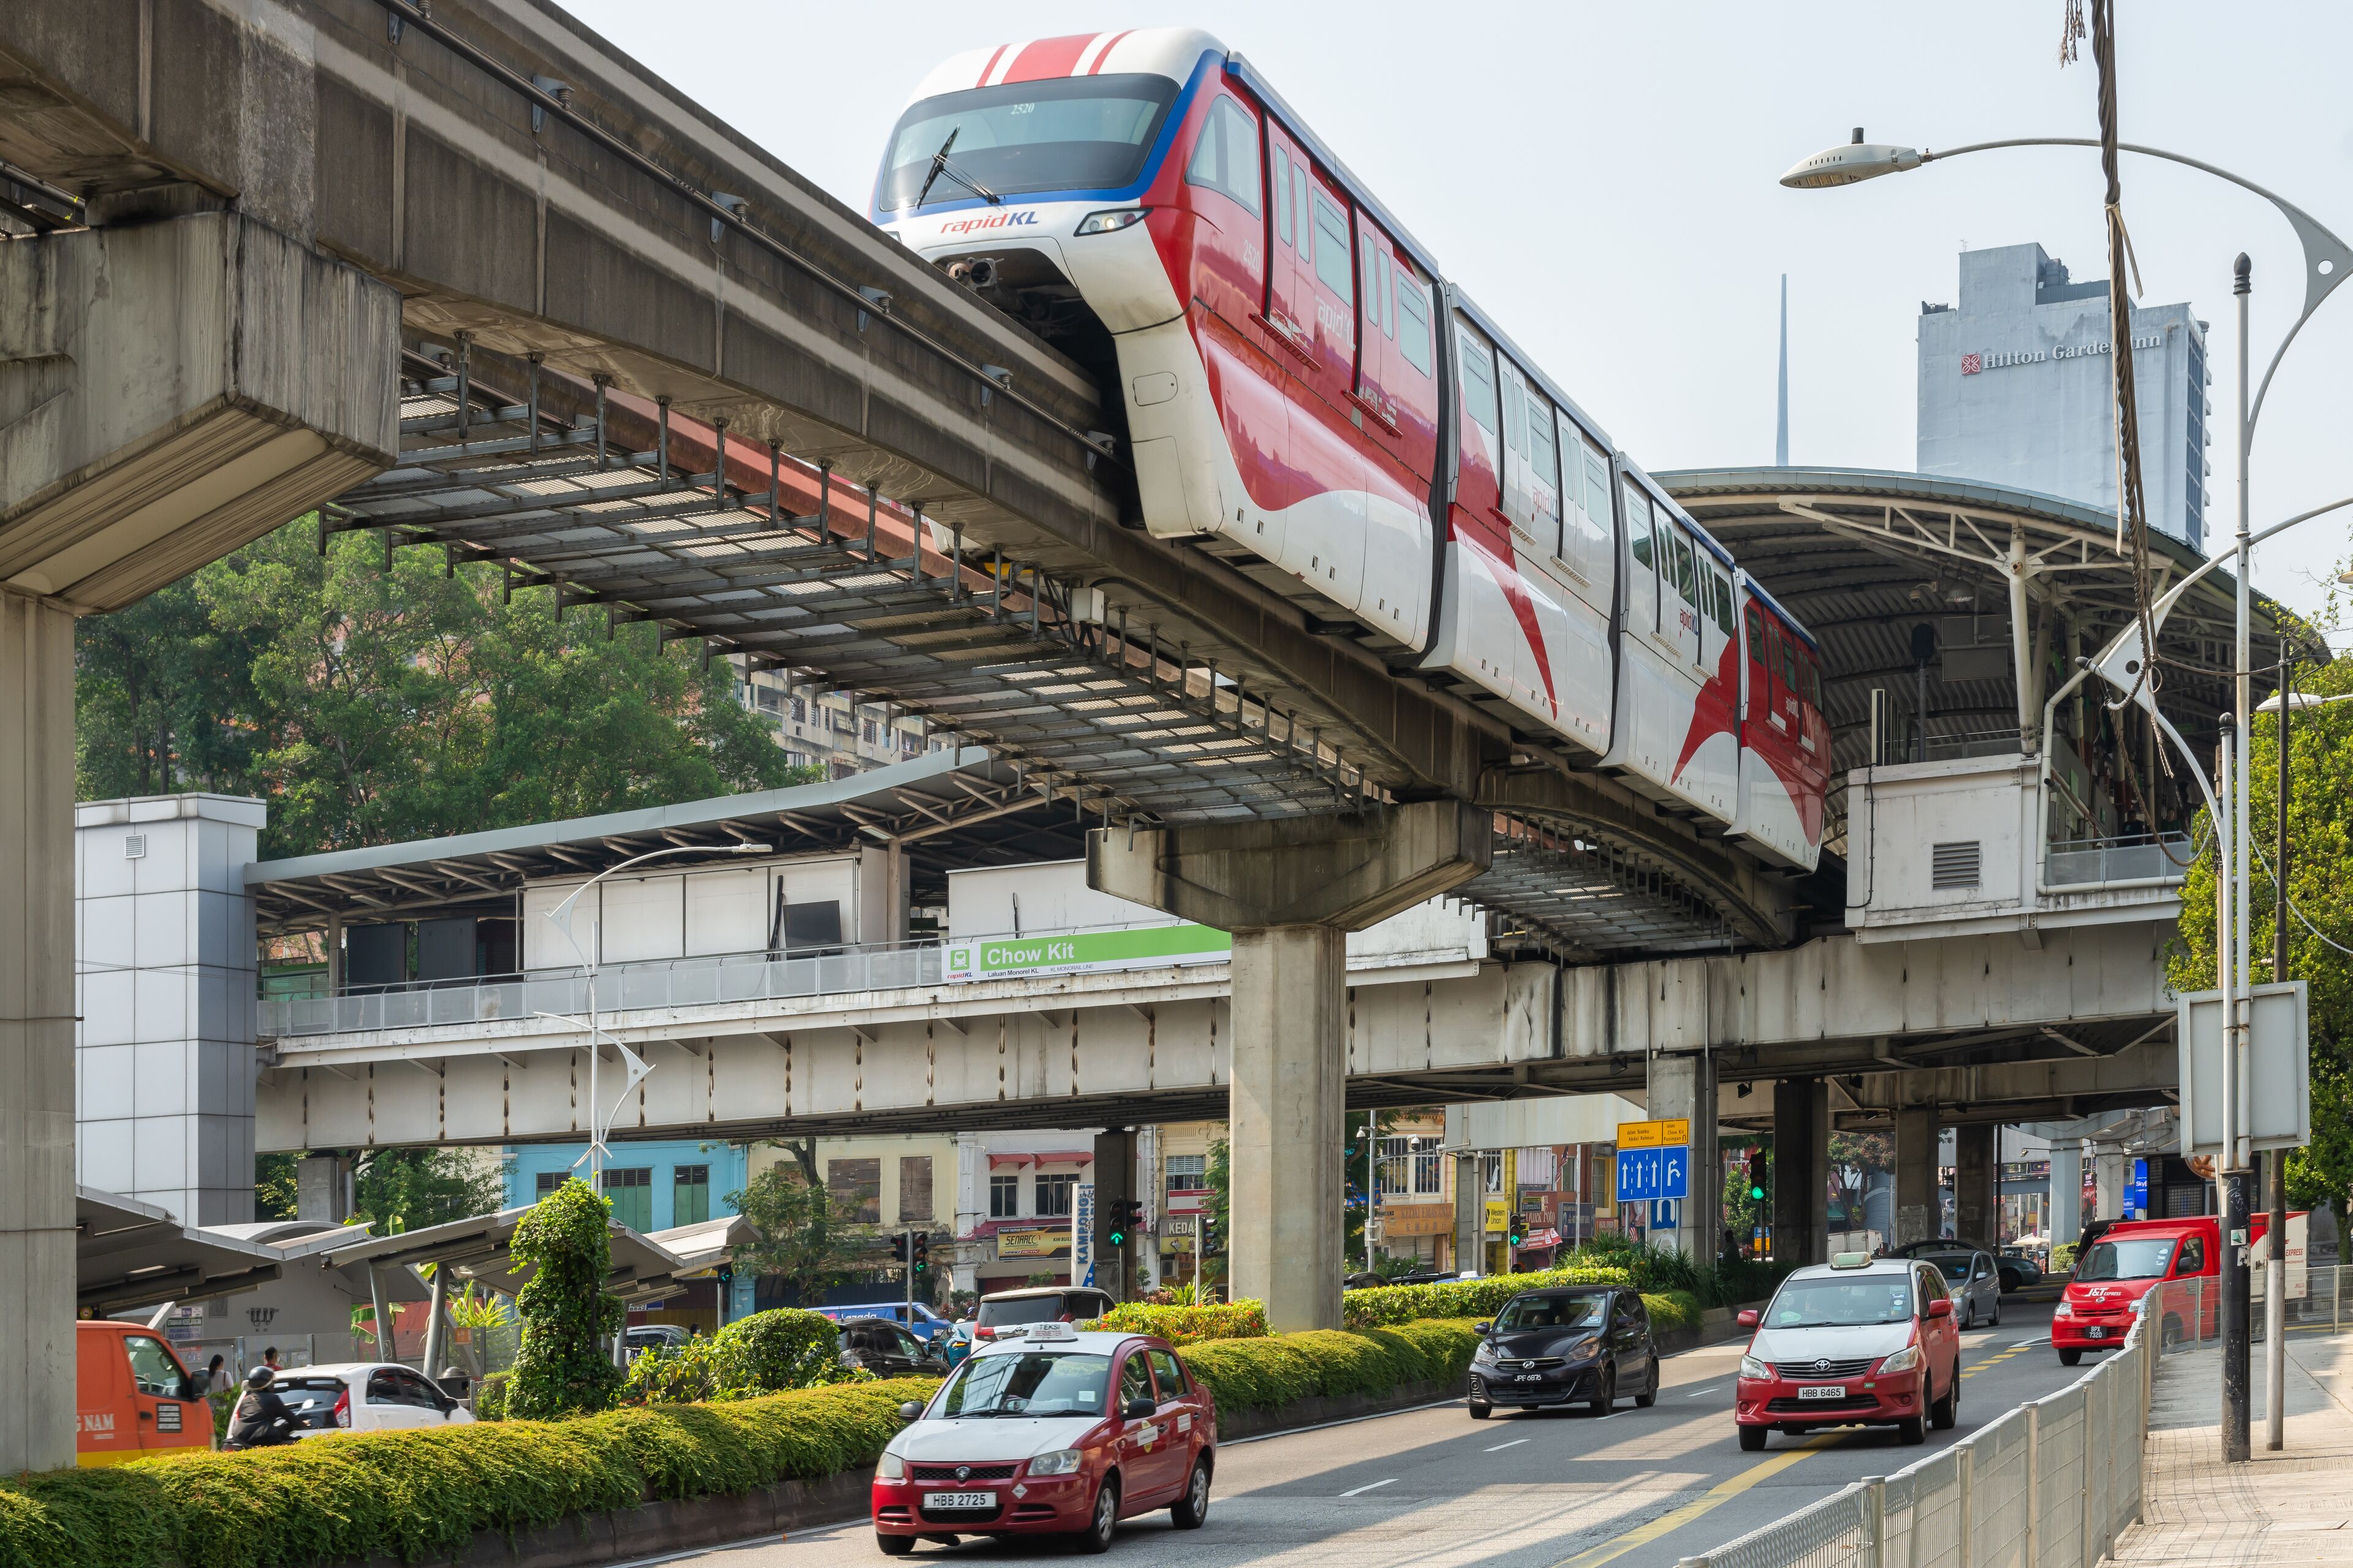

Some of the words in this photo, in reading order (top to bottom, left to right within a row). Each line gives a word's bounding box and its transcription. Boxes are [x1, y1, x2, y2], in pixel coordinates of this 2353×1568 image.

[1011, 102, 1034, 115] 2520
[941, 211, 1039, 234] rapidKL
[1243, 239, 1260, 273] 2520
[1983, 350, 2047, 369] Hilton
[1533, 485, 1559, 524] apidKL
[1680, 608, 1698, 636] apidKL
[987, 947, 1042, 965] Chow
[1048, 942, 1074, 960] Kit
[1402, 1206, 1420, 1219] KEDAI
[1169, 1222, 1196, 1234] KEDA
[2084, 1287, 2110, 1297] J&T
[1802, 1389, 1817, 1398] HBB
[1821, 1388, 1841, 1397] 6465
[83, 1413, 115, 1431] NAM
[933, 1495, 954, 1506] HBB
[958, 1494, 986, 1506] 2725
